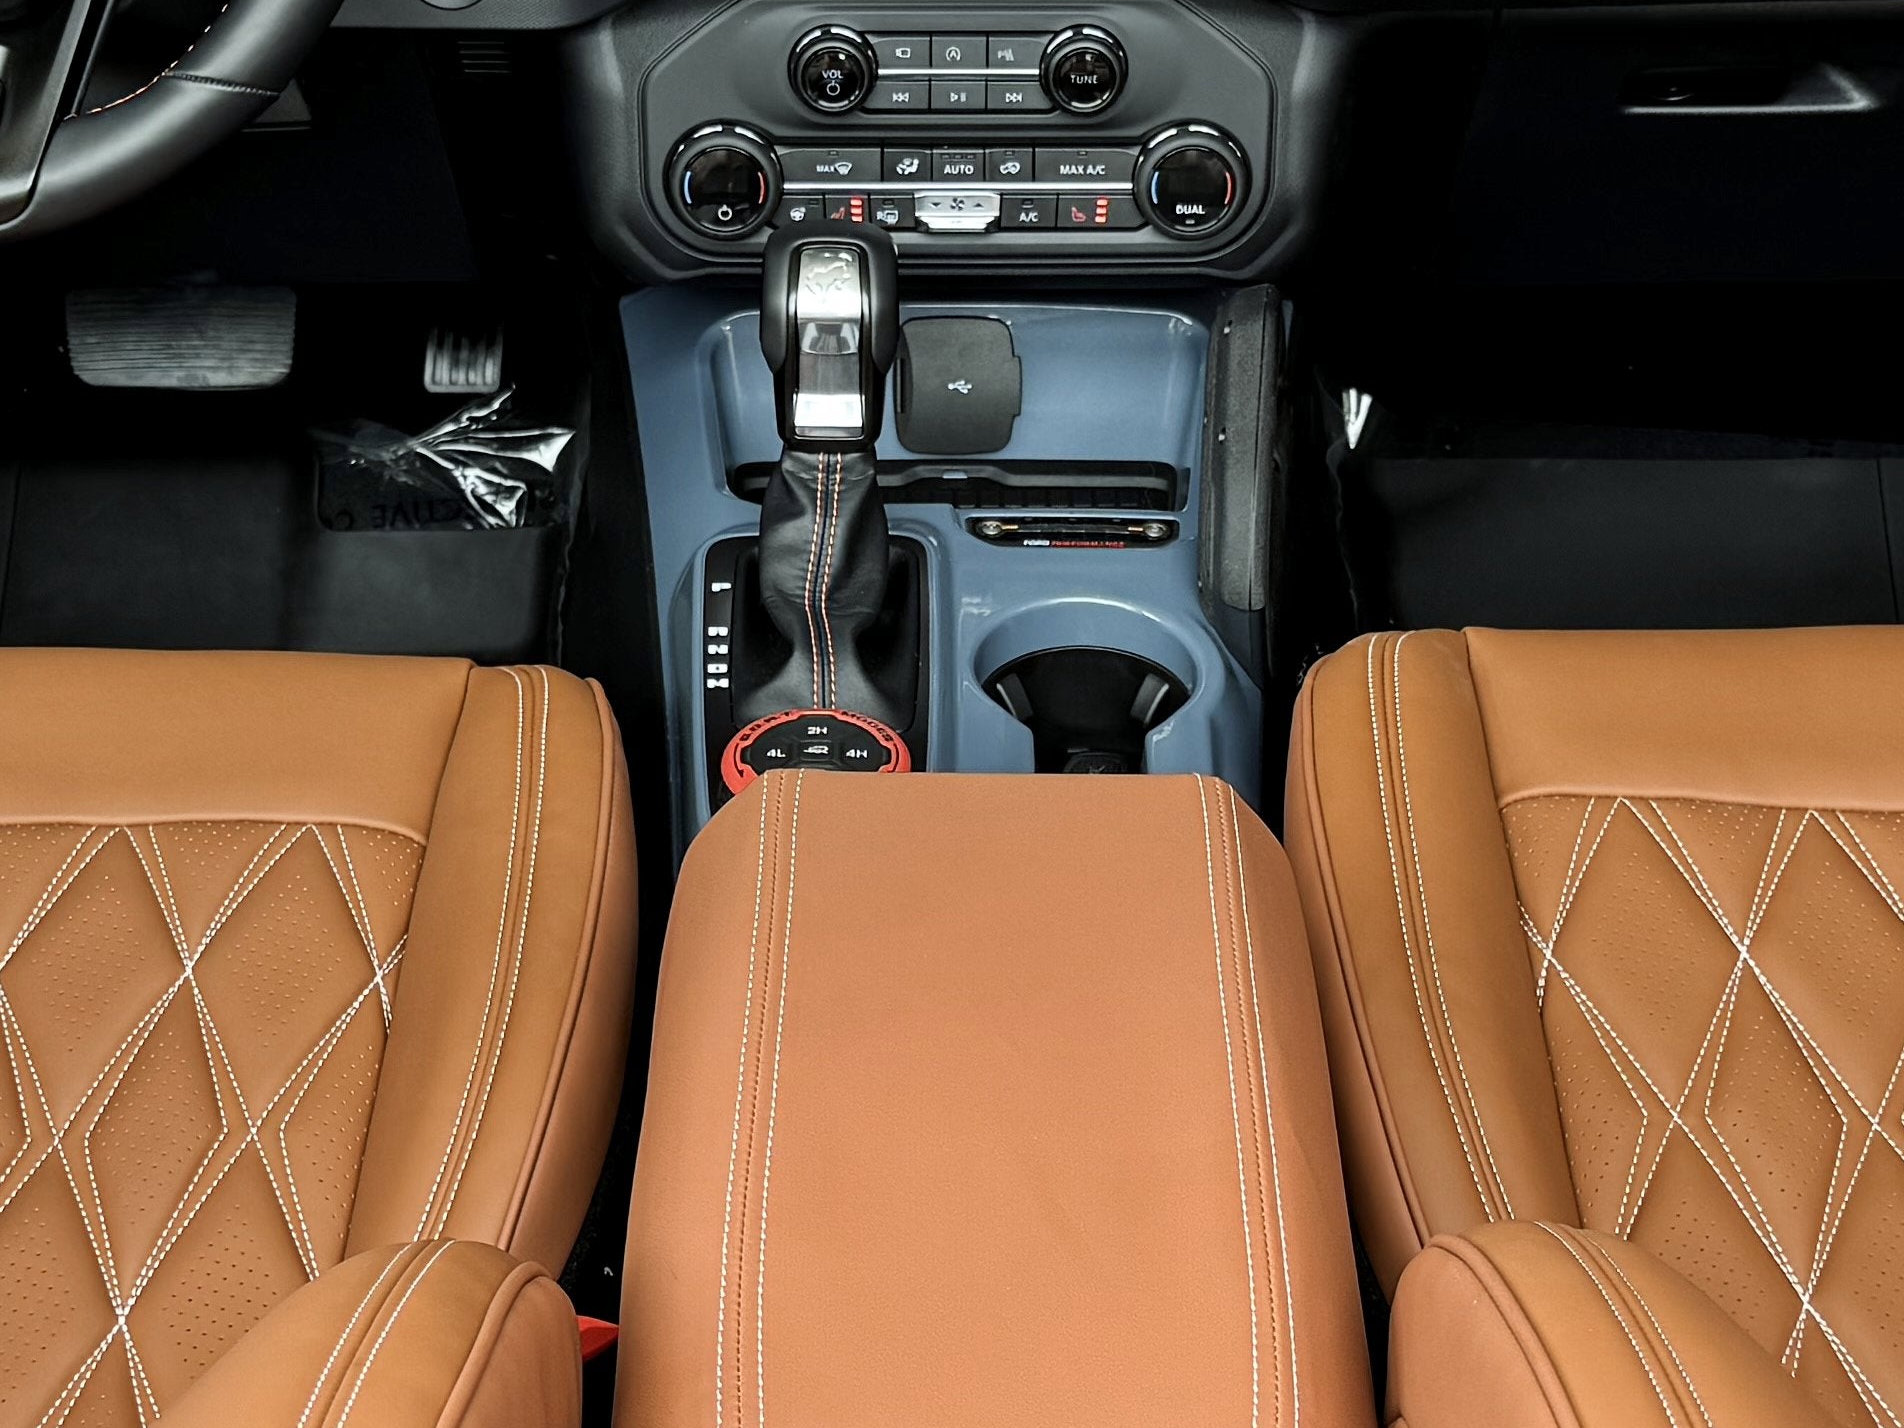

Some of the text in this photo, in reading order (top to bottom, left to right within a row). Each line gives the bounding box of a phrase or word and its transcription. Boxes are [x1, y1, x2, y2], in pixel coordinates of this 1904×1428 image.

[822, 70, 843, 79] VOL
[1070, 74, 1098, 84] TUNE
[816, 165, 834, 173] MAX
[944, 164, 974, 175] AUTO
[1060, 165, 1106, 175] MAX A/C
[1176, 204, 1205, 215] DUAL
[1019, 211, 1039, 222] A/C
[707, 663, 728, 674] D
[807, 726, 828, 735] 2H
[767, 749, 786, 758] 4L
[846, 749, 868, 759] 4H
